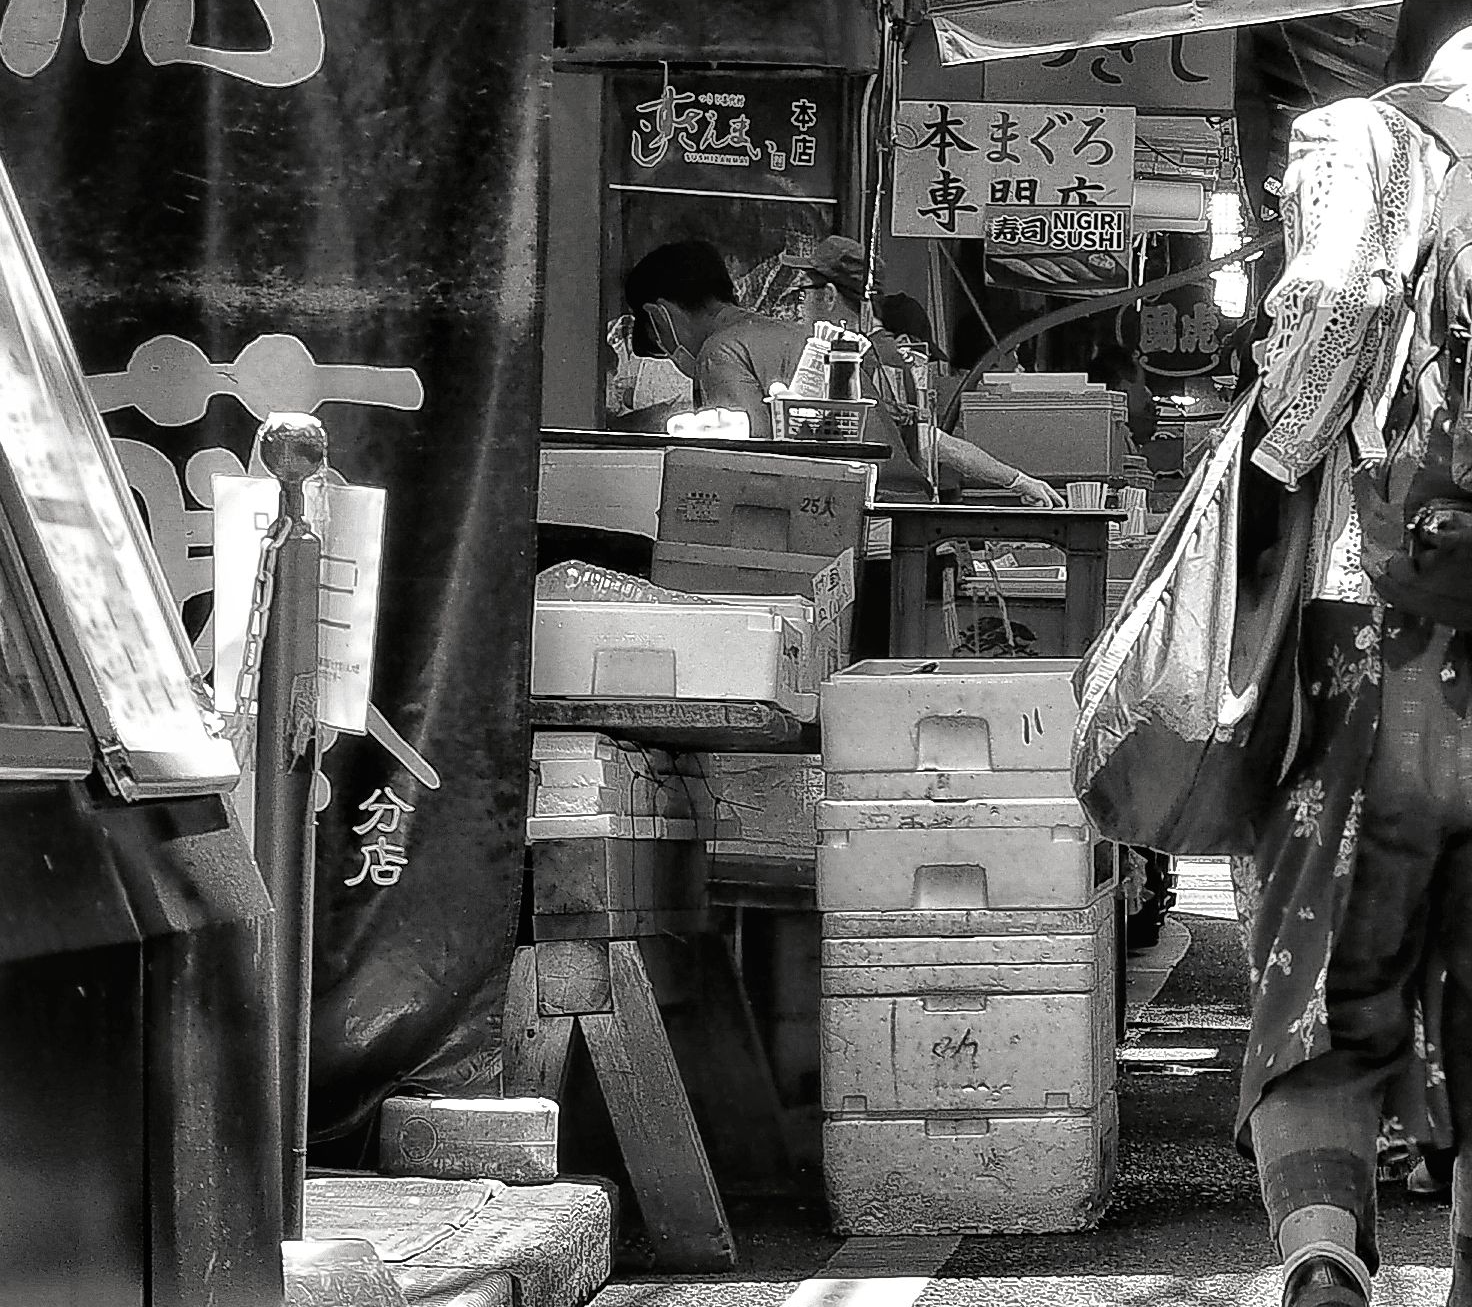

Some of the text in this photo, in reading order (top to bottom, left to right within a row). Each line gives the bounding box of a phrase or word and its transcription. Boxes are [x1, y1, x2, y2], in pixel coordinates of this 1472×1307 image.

[790, 99, 817, 166] 本店
[917, 103, 1114, 168] 本まぐろ
[992, 216, 1047, 244] 寿司
[1053, 212, 1123, 232] NIGIRI
[1053, 230, 1123, 251] SUSHI
[344, 785, 416, 888] 分店
